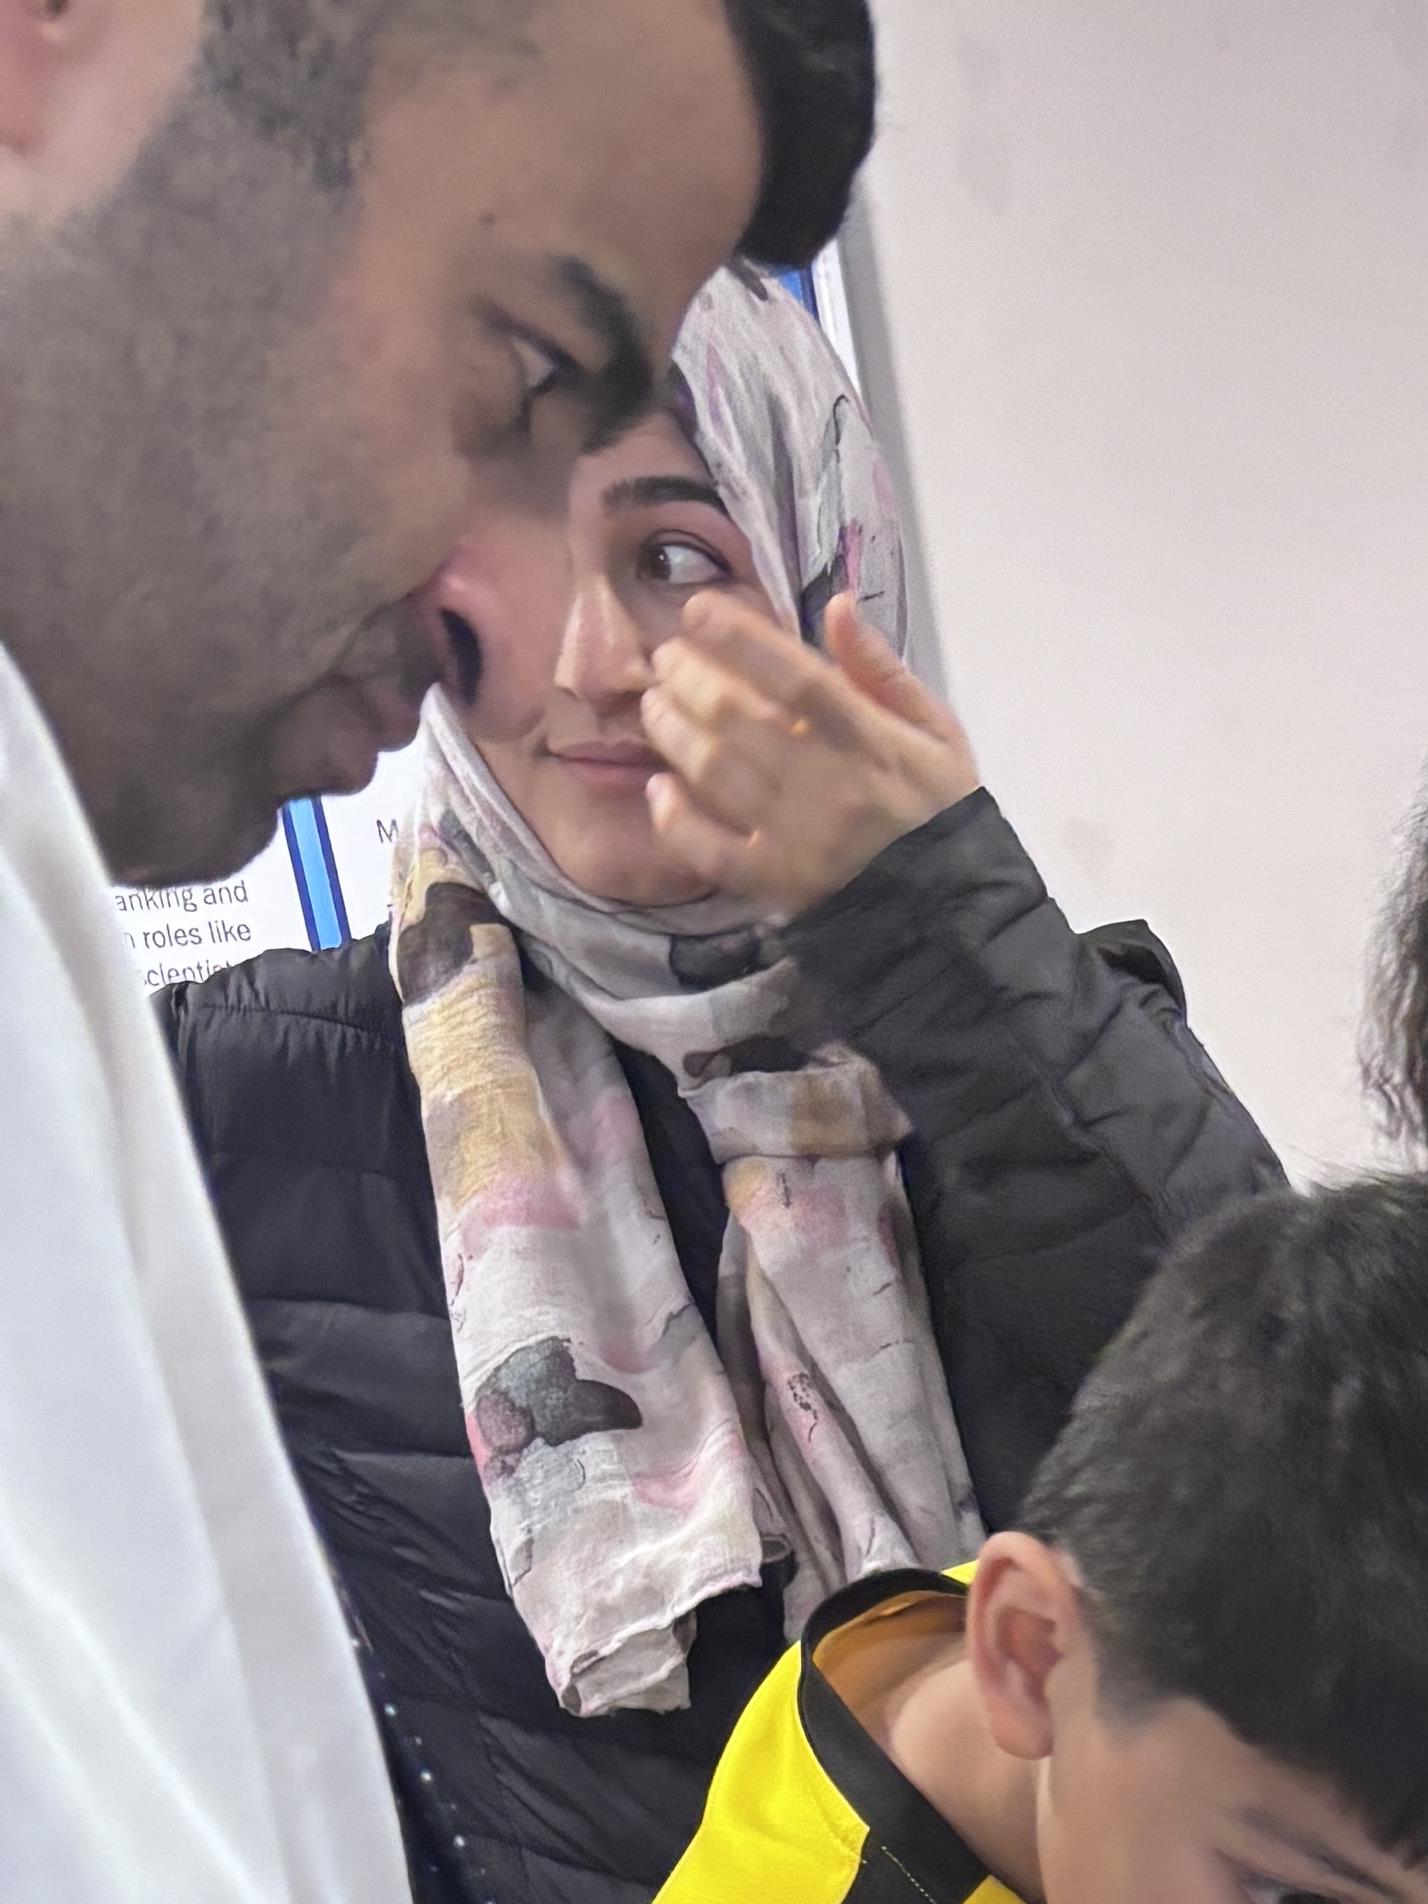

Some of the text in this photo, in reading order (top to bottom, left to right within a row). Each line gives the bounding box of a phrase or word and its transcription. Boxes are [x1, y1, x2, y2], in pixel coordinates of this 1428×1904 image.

[115, 880, 249, 912] anking and
[143, 923, 202, 949] roles
[208, 920, 251, 944] like
